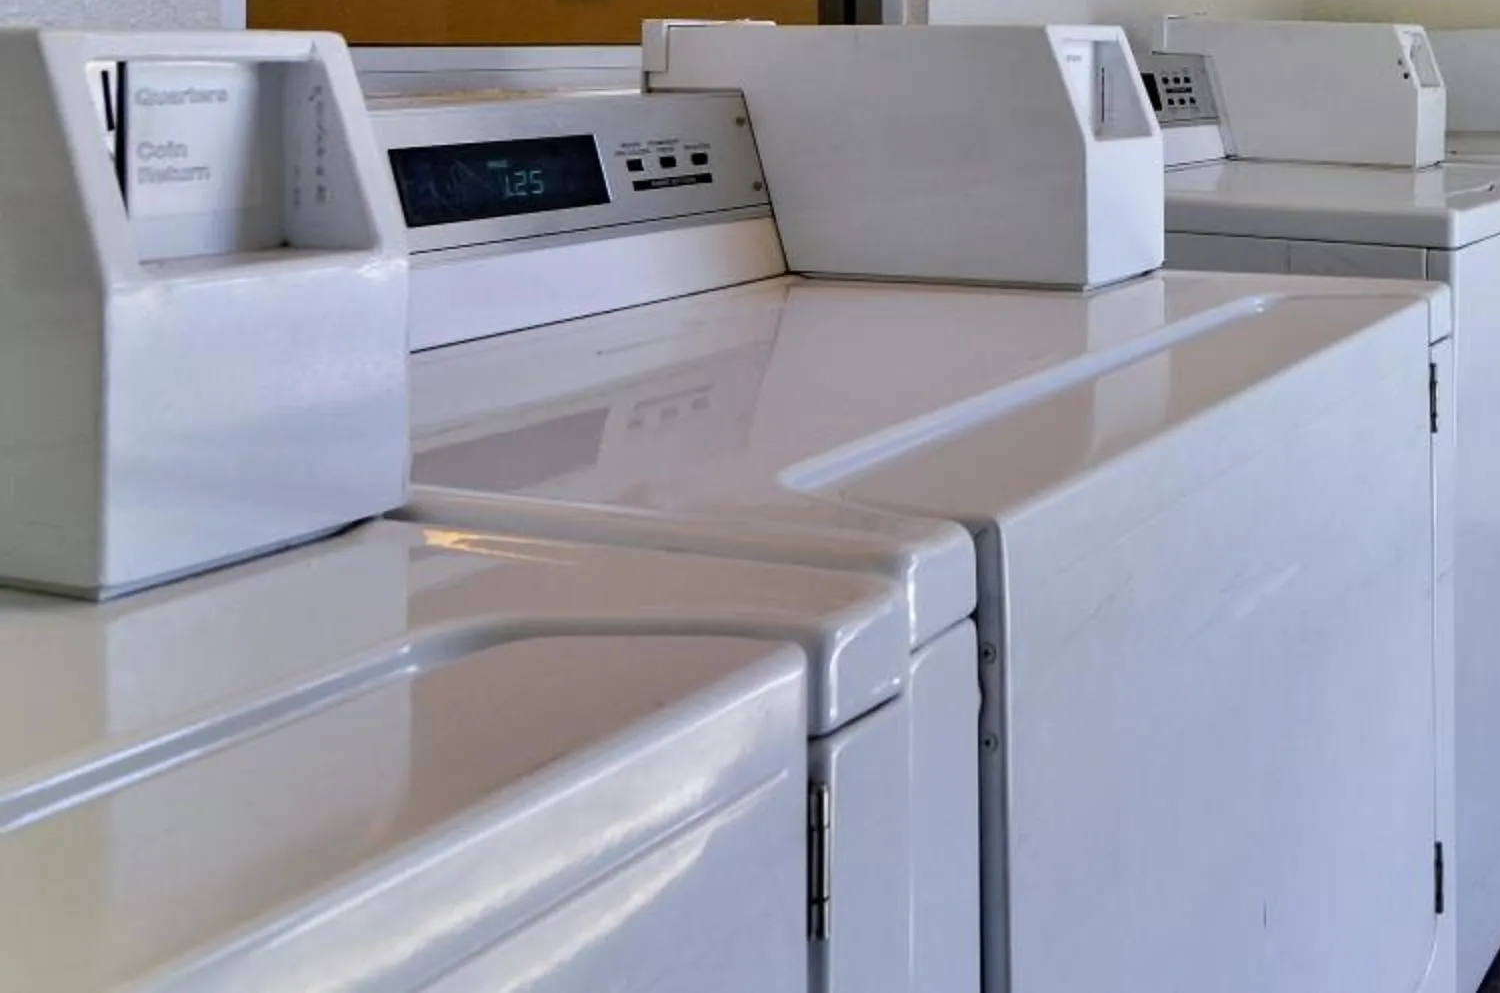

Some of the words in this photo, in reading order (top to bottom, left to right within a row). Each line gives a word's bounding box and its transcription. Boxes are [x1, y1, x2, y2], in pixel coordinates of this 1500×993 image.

[134, 87, 229, 107] Quarters
[136, 140, 189, 161] Coin
[137, 165, 212, 185] Return
